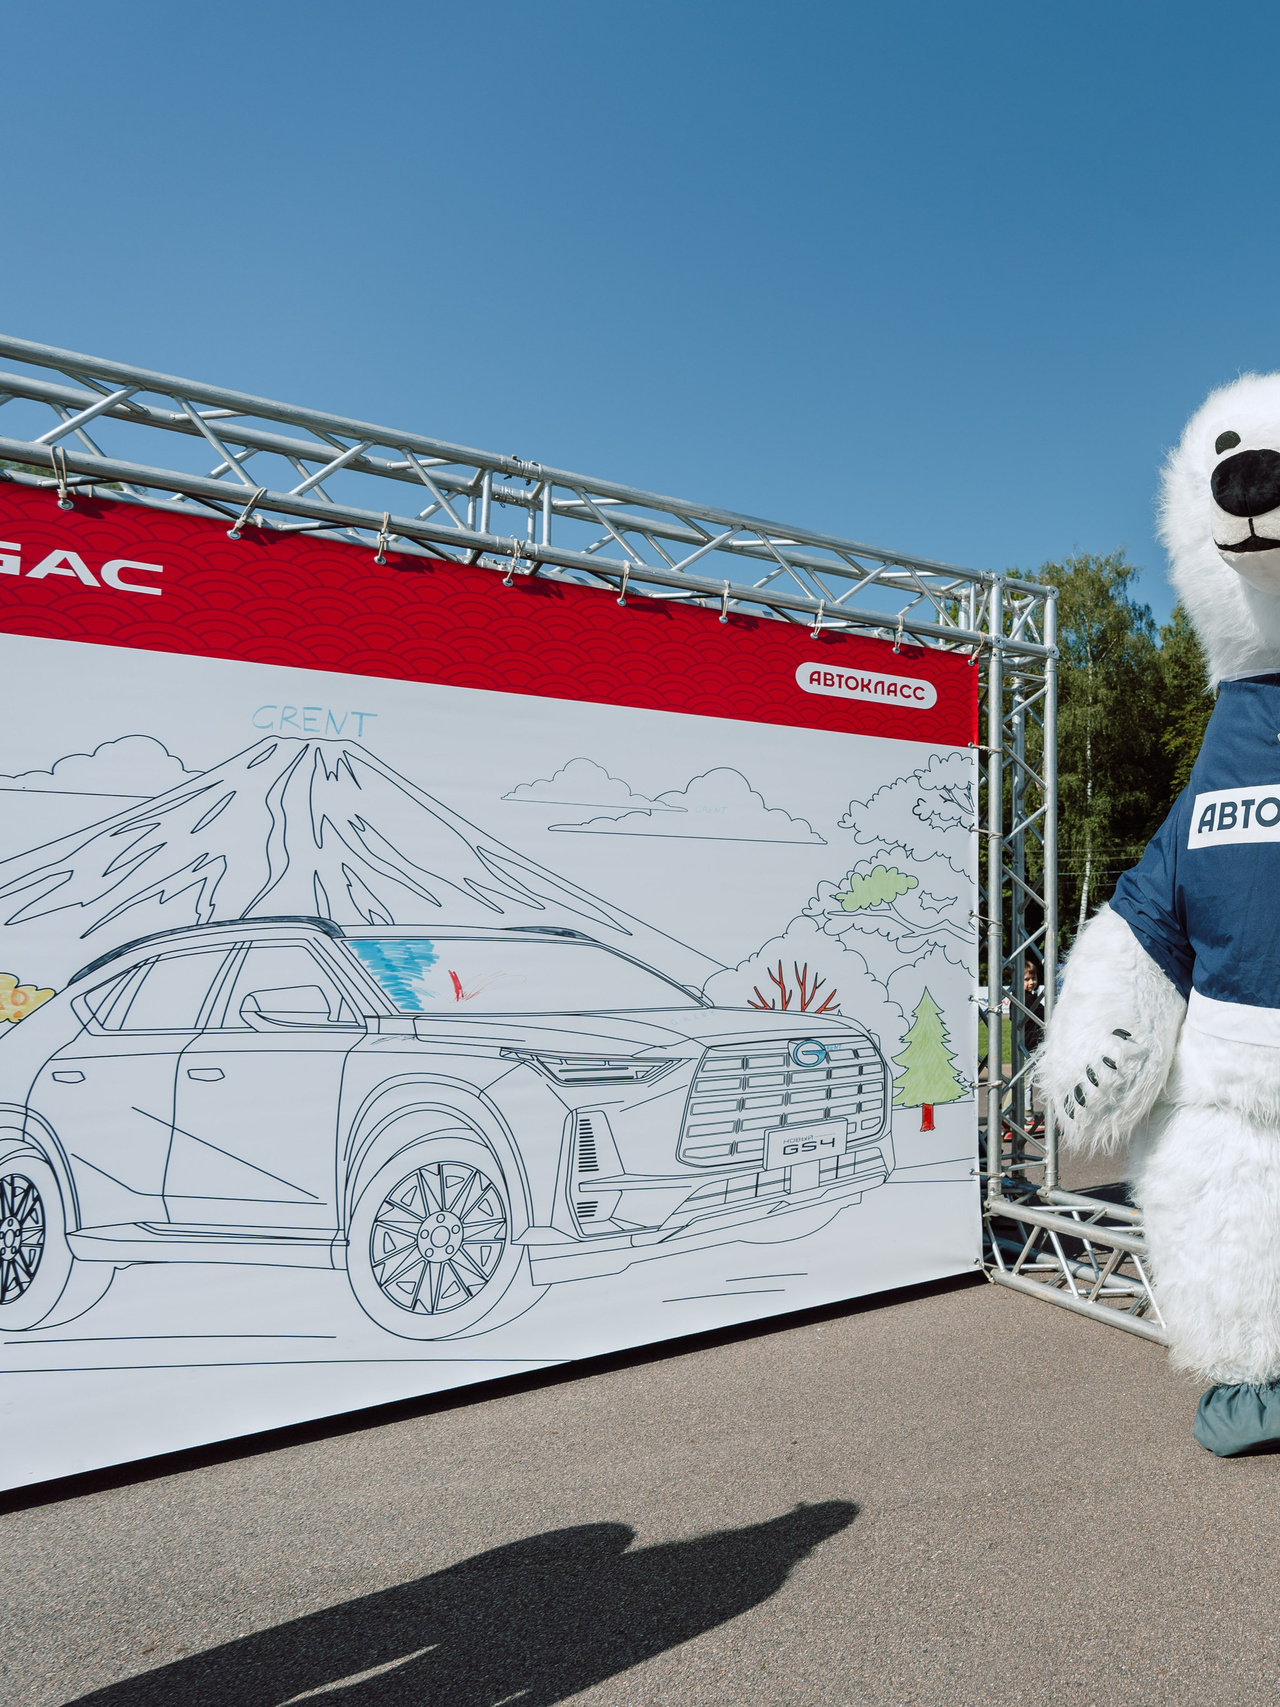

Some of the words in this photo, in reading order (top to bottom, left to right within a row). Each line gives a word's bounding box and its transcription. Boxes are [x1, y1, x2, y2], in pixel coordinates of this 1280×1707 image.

[809, 670, 926, 701] АВТОКЛАСС
[252, 705, 378, 738] GRENT
[783, 1138, 836, 1155] GS4
